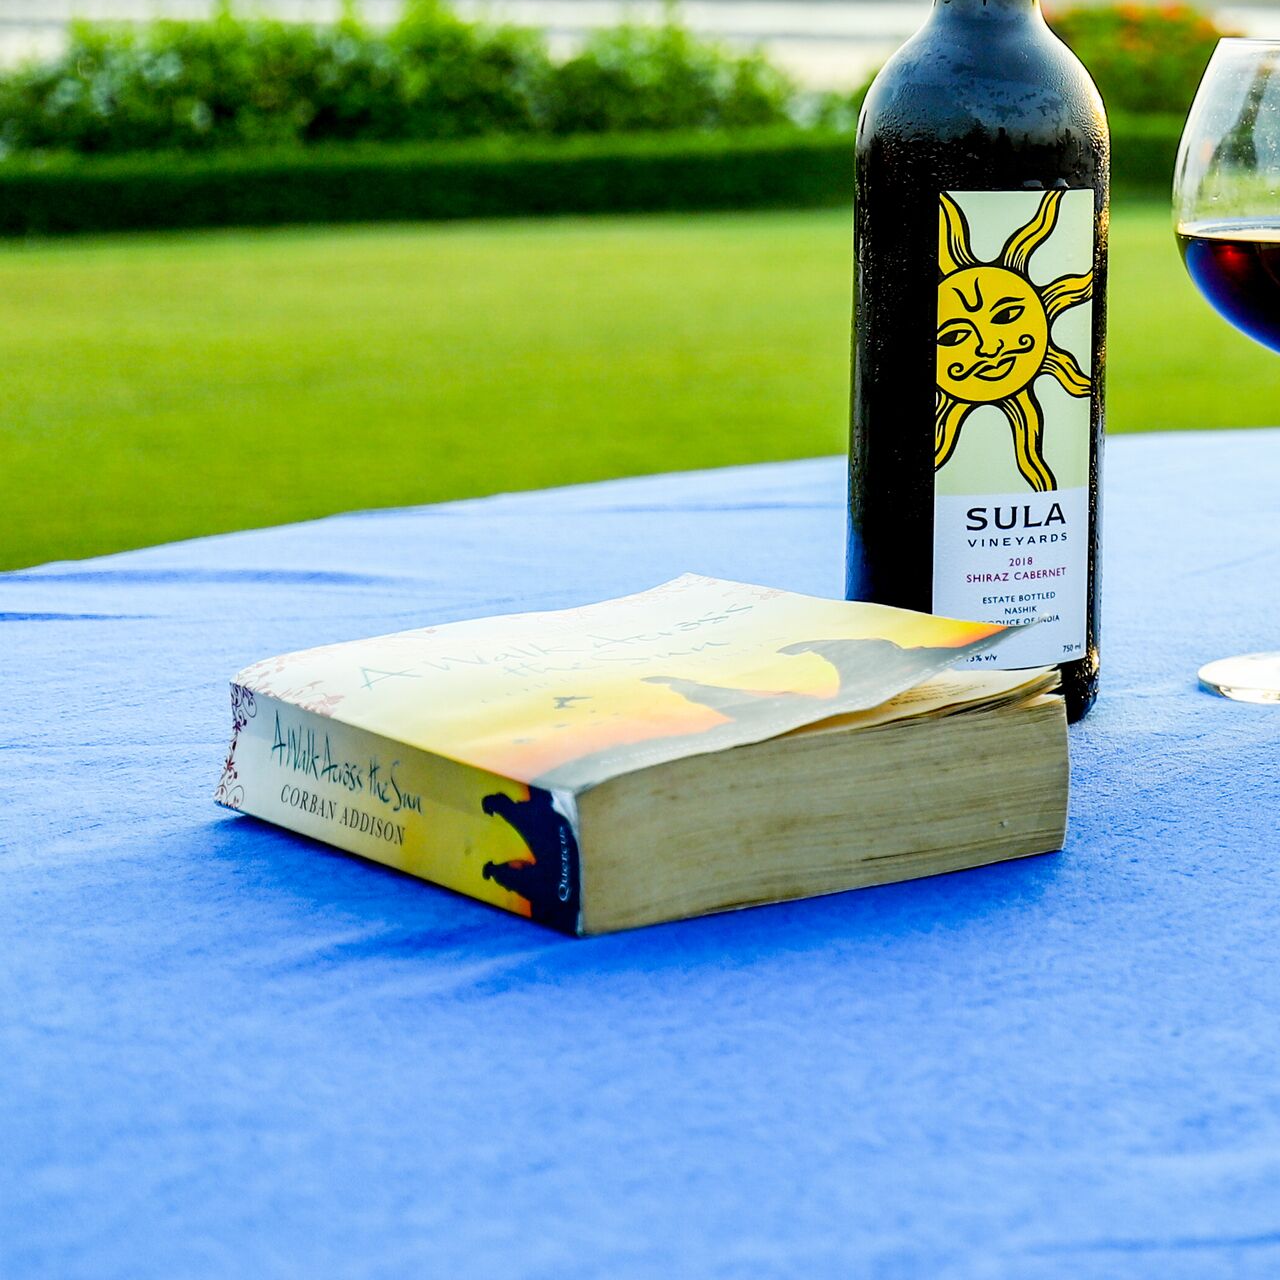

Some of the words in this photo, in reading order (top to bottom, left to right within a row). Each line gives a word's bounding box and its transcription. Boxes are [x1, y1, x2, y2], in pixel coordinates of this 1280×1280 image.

[966, 502, 1067, 531] SULA
[967, 532, 1068, 548] VINEYARDS
[1009, 556, 1034, 568] 2018
[966, 572, 1010, 584] SHIRAZ
[1014, 567, 1067, 581] CABERNET
[982, 594, 1016, 605] ESTATE
[1018, 591, 1056, 603] BOTTLED
[1004, 605, 1037, 615] NASHIK
[1062, 644, 1074, 653] 750
[966, 655, 982, 663] 3%
[984, 652, 998, 662] v/v
[360, 666, 423, 691] A
[271, 709, 286, 767] A
[286, 725, 320, 782] Walk
[320, 730, 364, 792] Across
[367, 754, 390, 804] the
[391, 760, 423, 815] Sun
[280, 784, 337, 821] CORBAN
[339, 807, 406, 846] ADDISON
